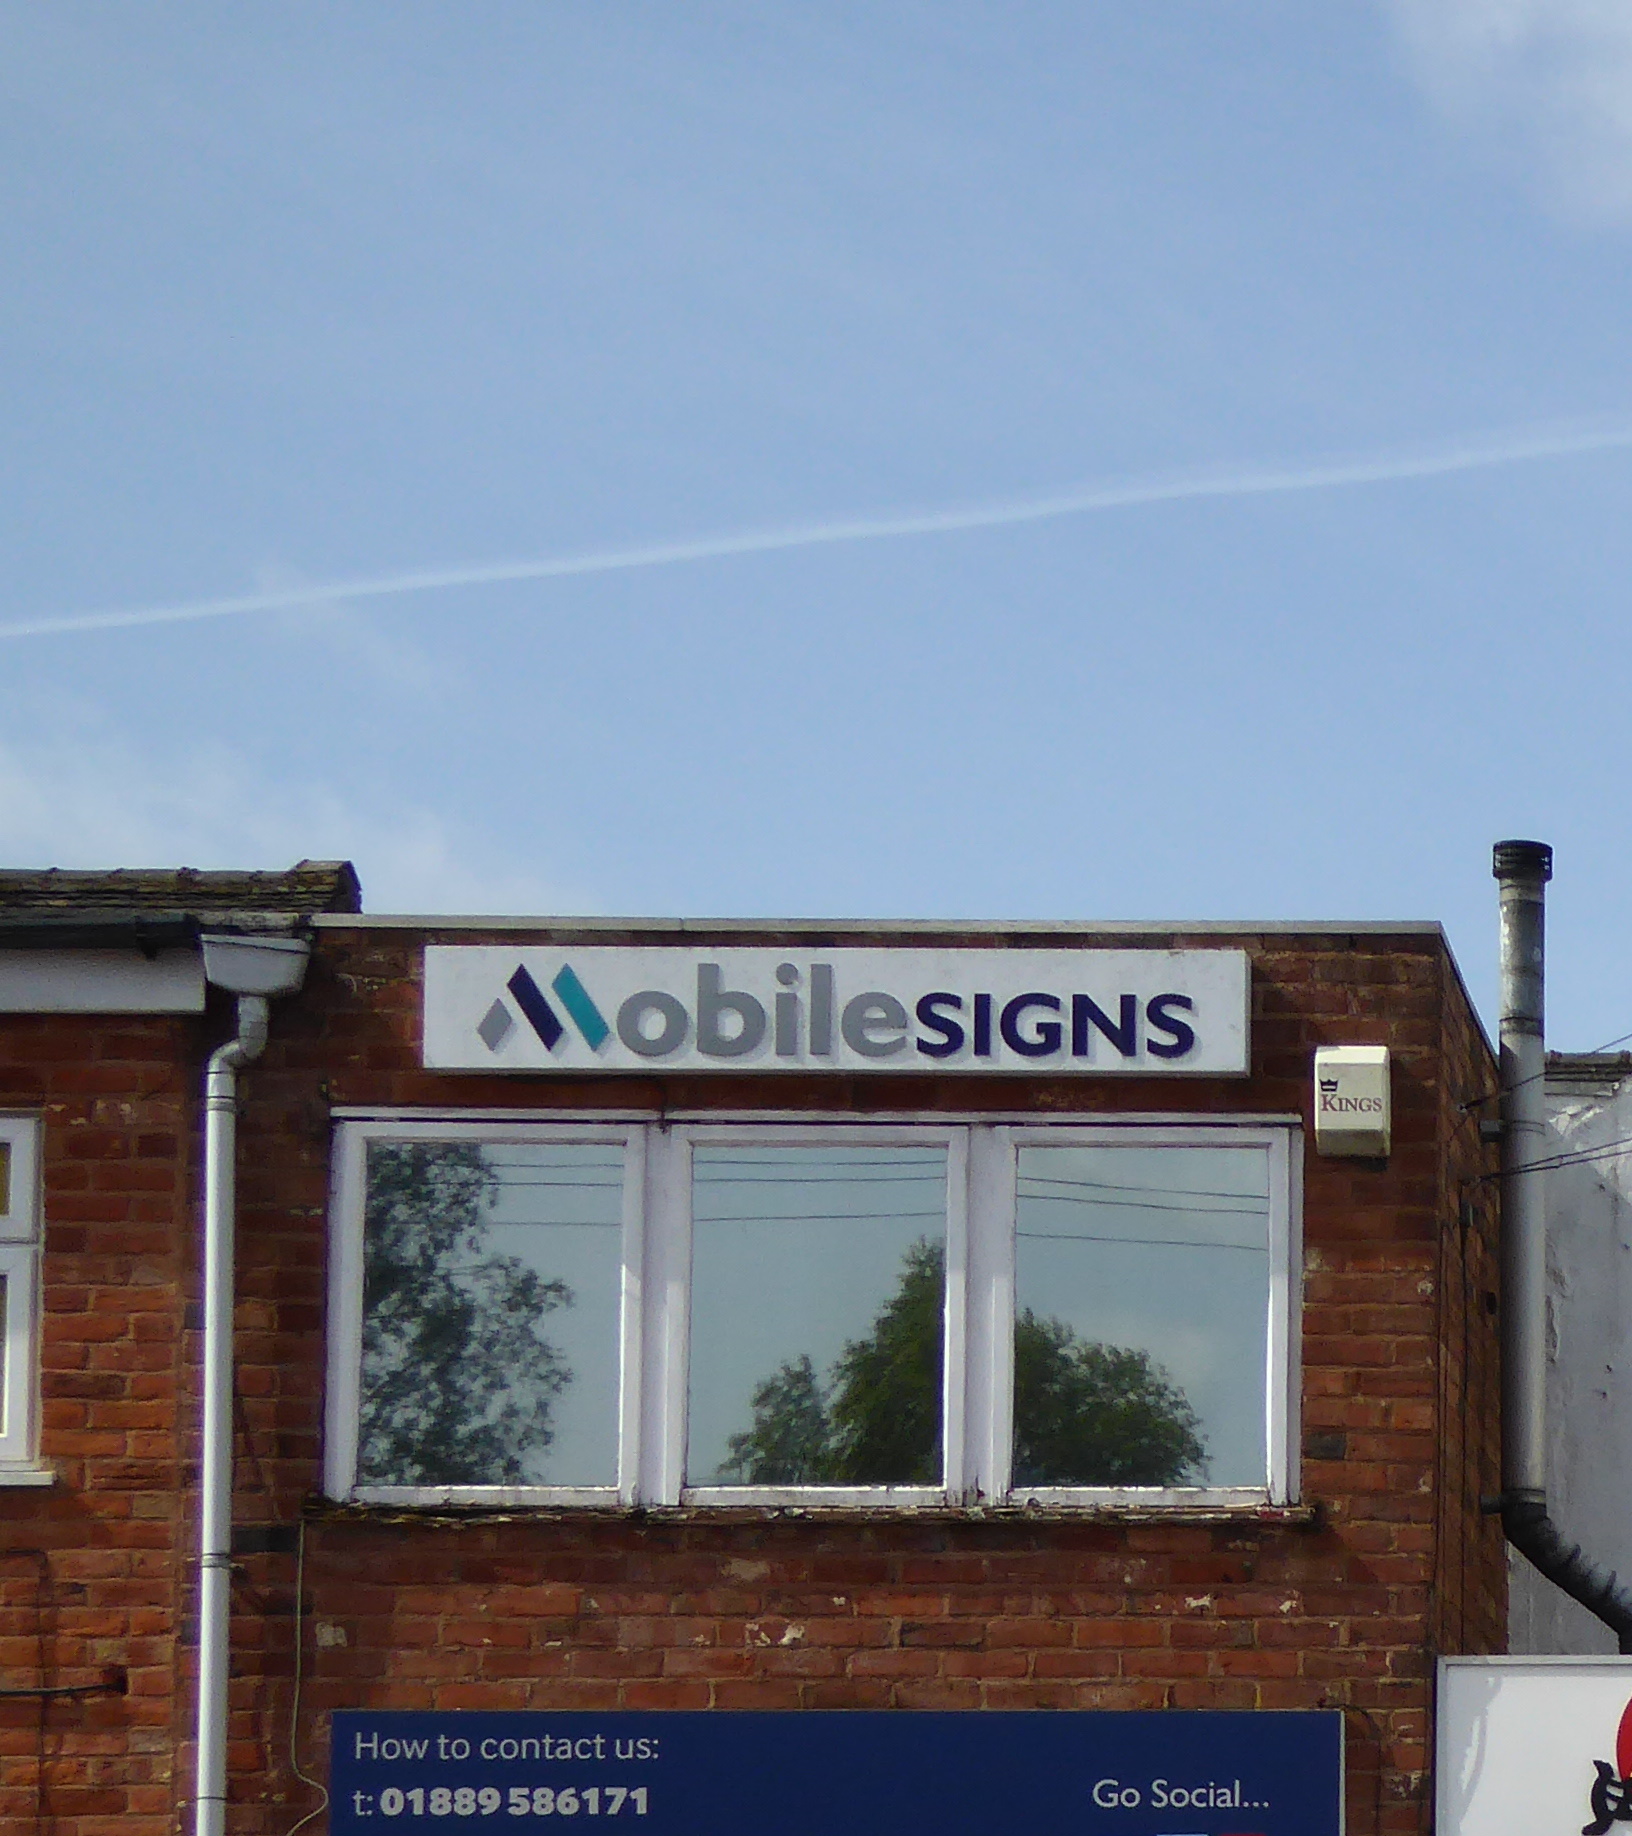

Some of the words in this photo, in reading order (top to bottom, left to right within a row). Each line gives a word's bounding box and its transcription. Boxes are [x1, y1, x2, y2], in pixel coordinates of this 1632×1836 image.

[354, 1732, 429, 1760] How
[437, 1733, 471, 1760] to
[480, 1733, 606, 1760] contact
[615, 1736, 660, 1760] us:
[352, 1790, 374, 1816] t:
[380, 1787, 501, 1816] 01889
[507, 1787, 648, 1816] 586171
[1092, 1779, 1141, 1808] Go
